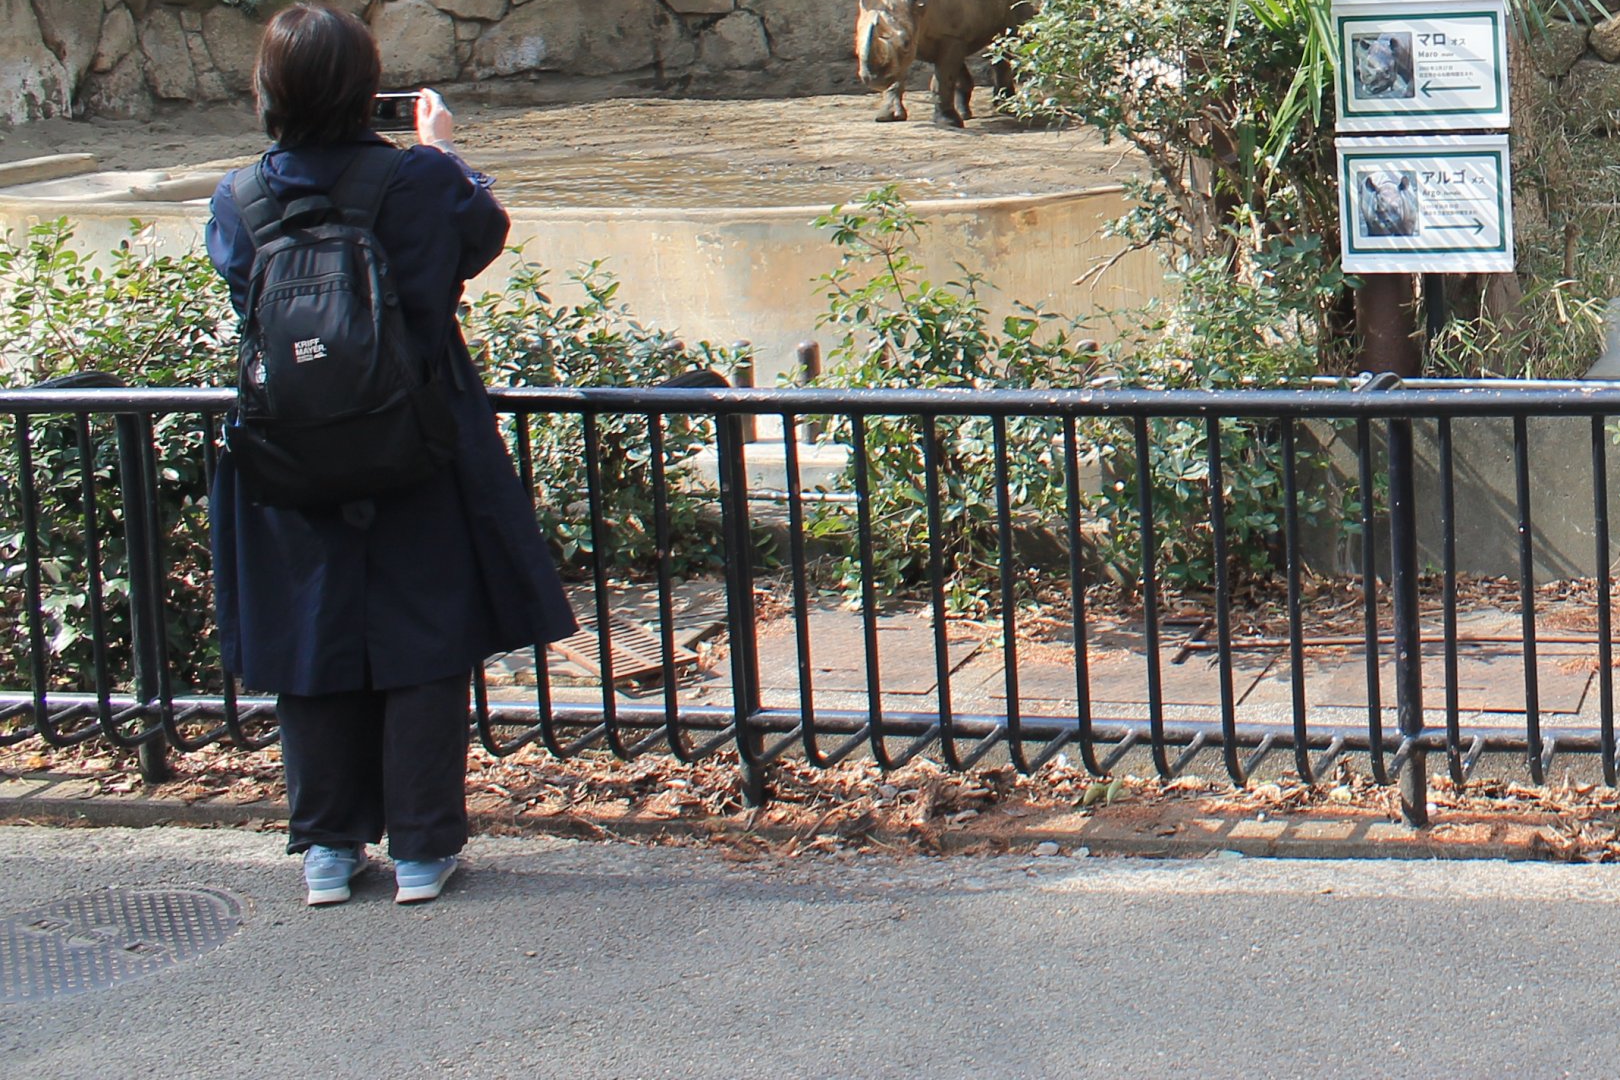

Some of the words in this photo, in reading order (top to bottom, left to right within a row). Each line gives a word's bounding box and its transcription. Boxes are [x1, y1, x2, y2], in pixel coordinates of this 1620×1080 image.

[1417, 34, 1446, 46] マロ
[1451, 38, 1466, 46] オス
[1422, 170, 1466, 184] アルゴ
[294, 338, 320, 349] KRIFF
